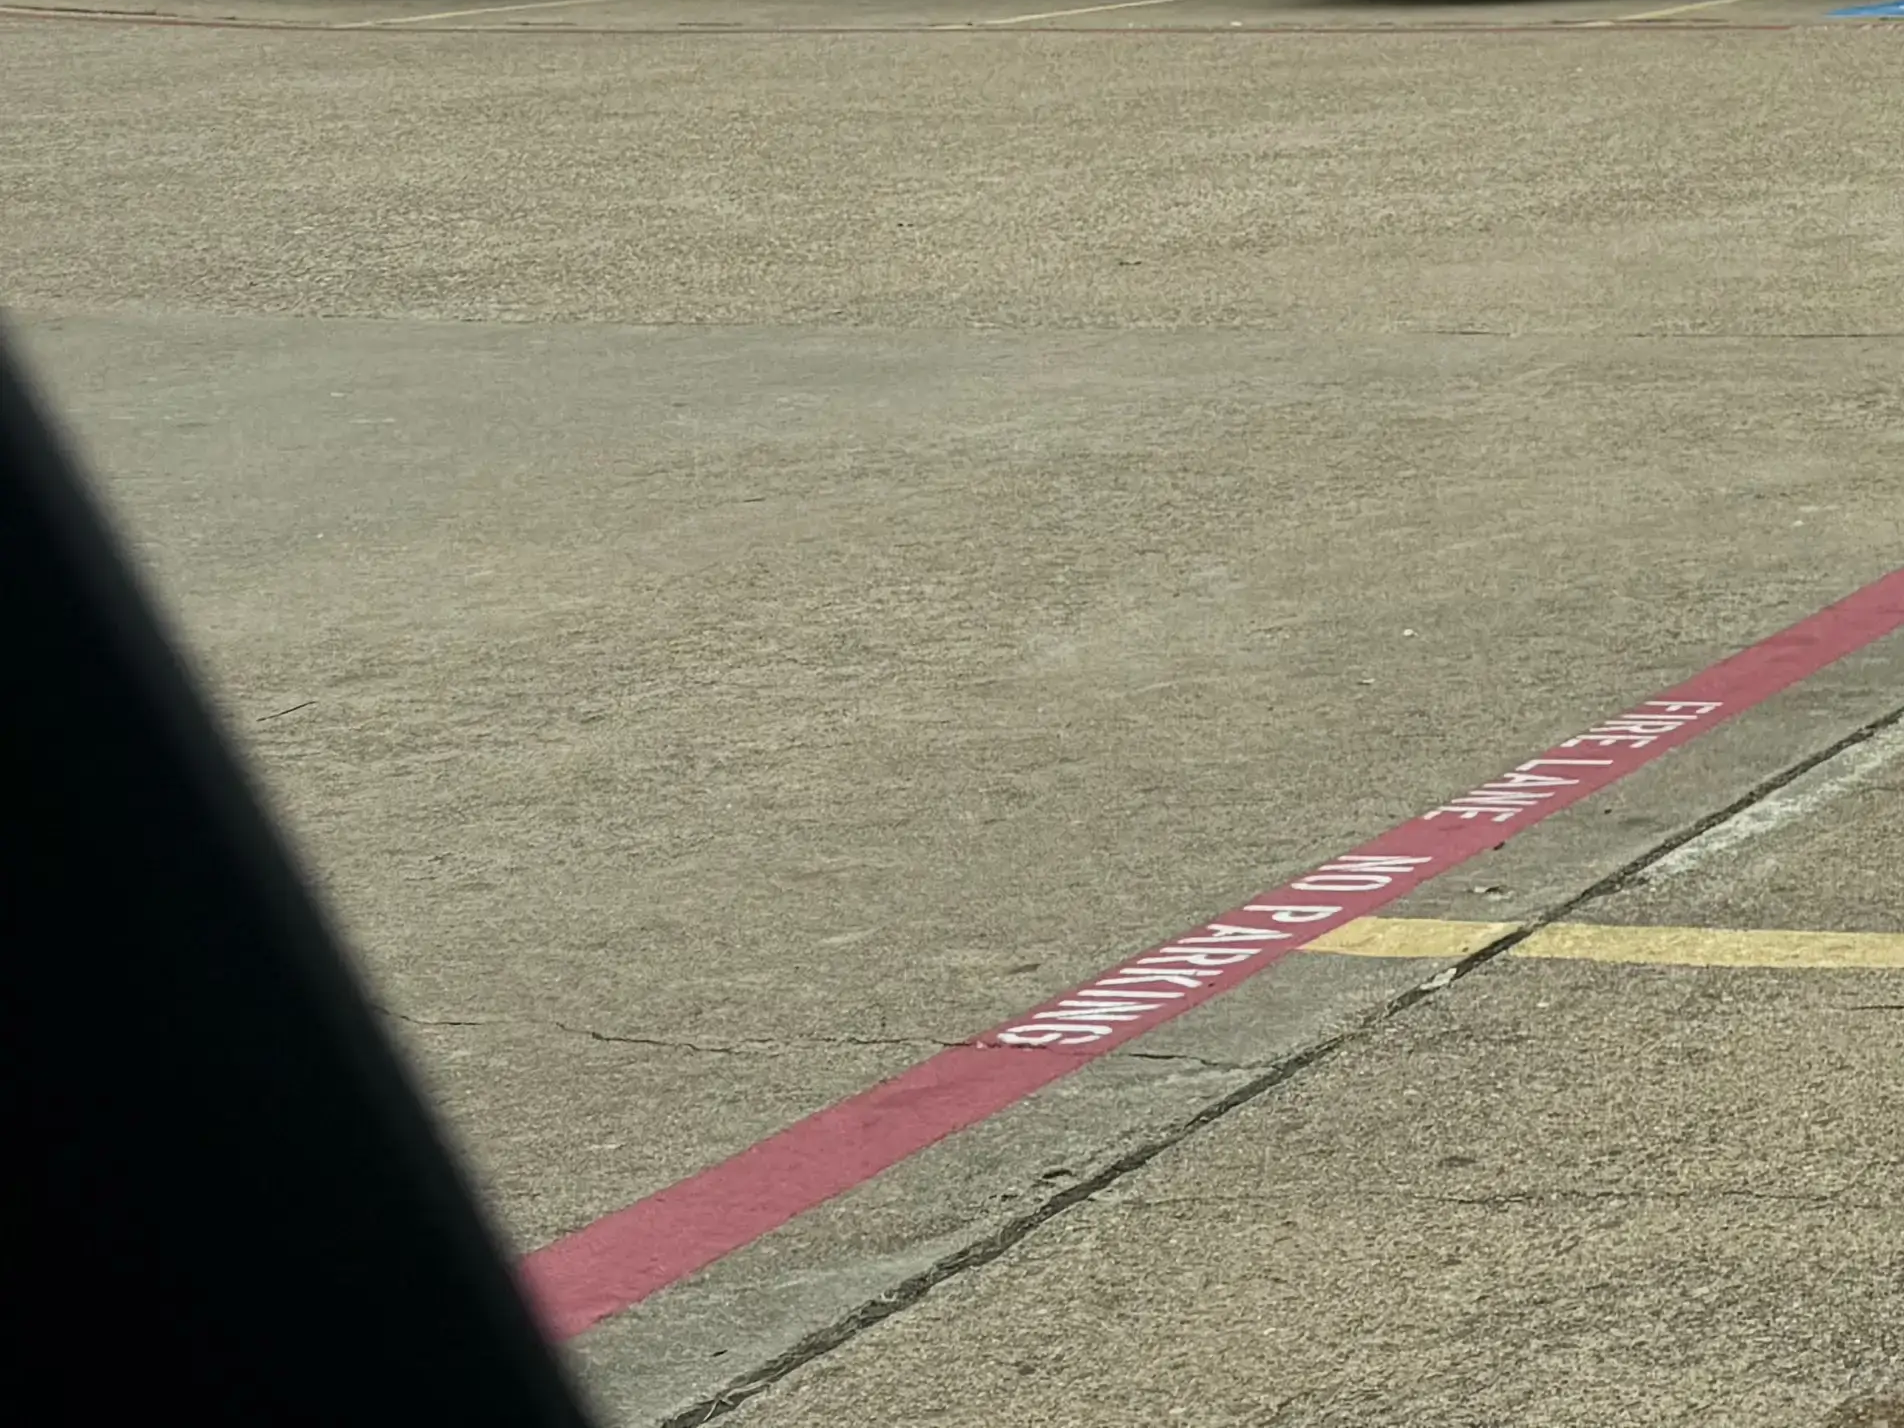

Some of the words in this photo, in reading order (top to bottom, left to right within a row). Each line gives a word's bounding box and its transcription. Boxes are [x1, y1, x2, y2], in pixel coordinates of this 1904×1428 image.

[1560, 699, 1723, 749] FIRE
[1422, 757, 1614, 823] LANE
[1289, 853, 1433, 892] NO
[996, 902, 1343, 1047] PARKING
